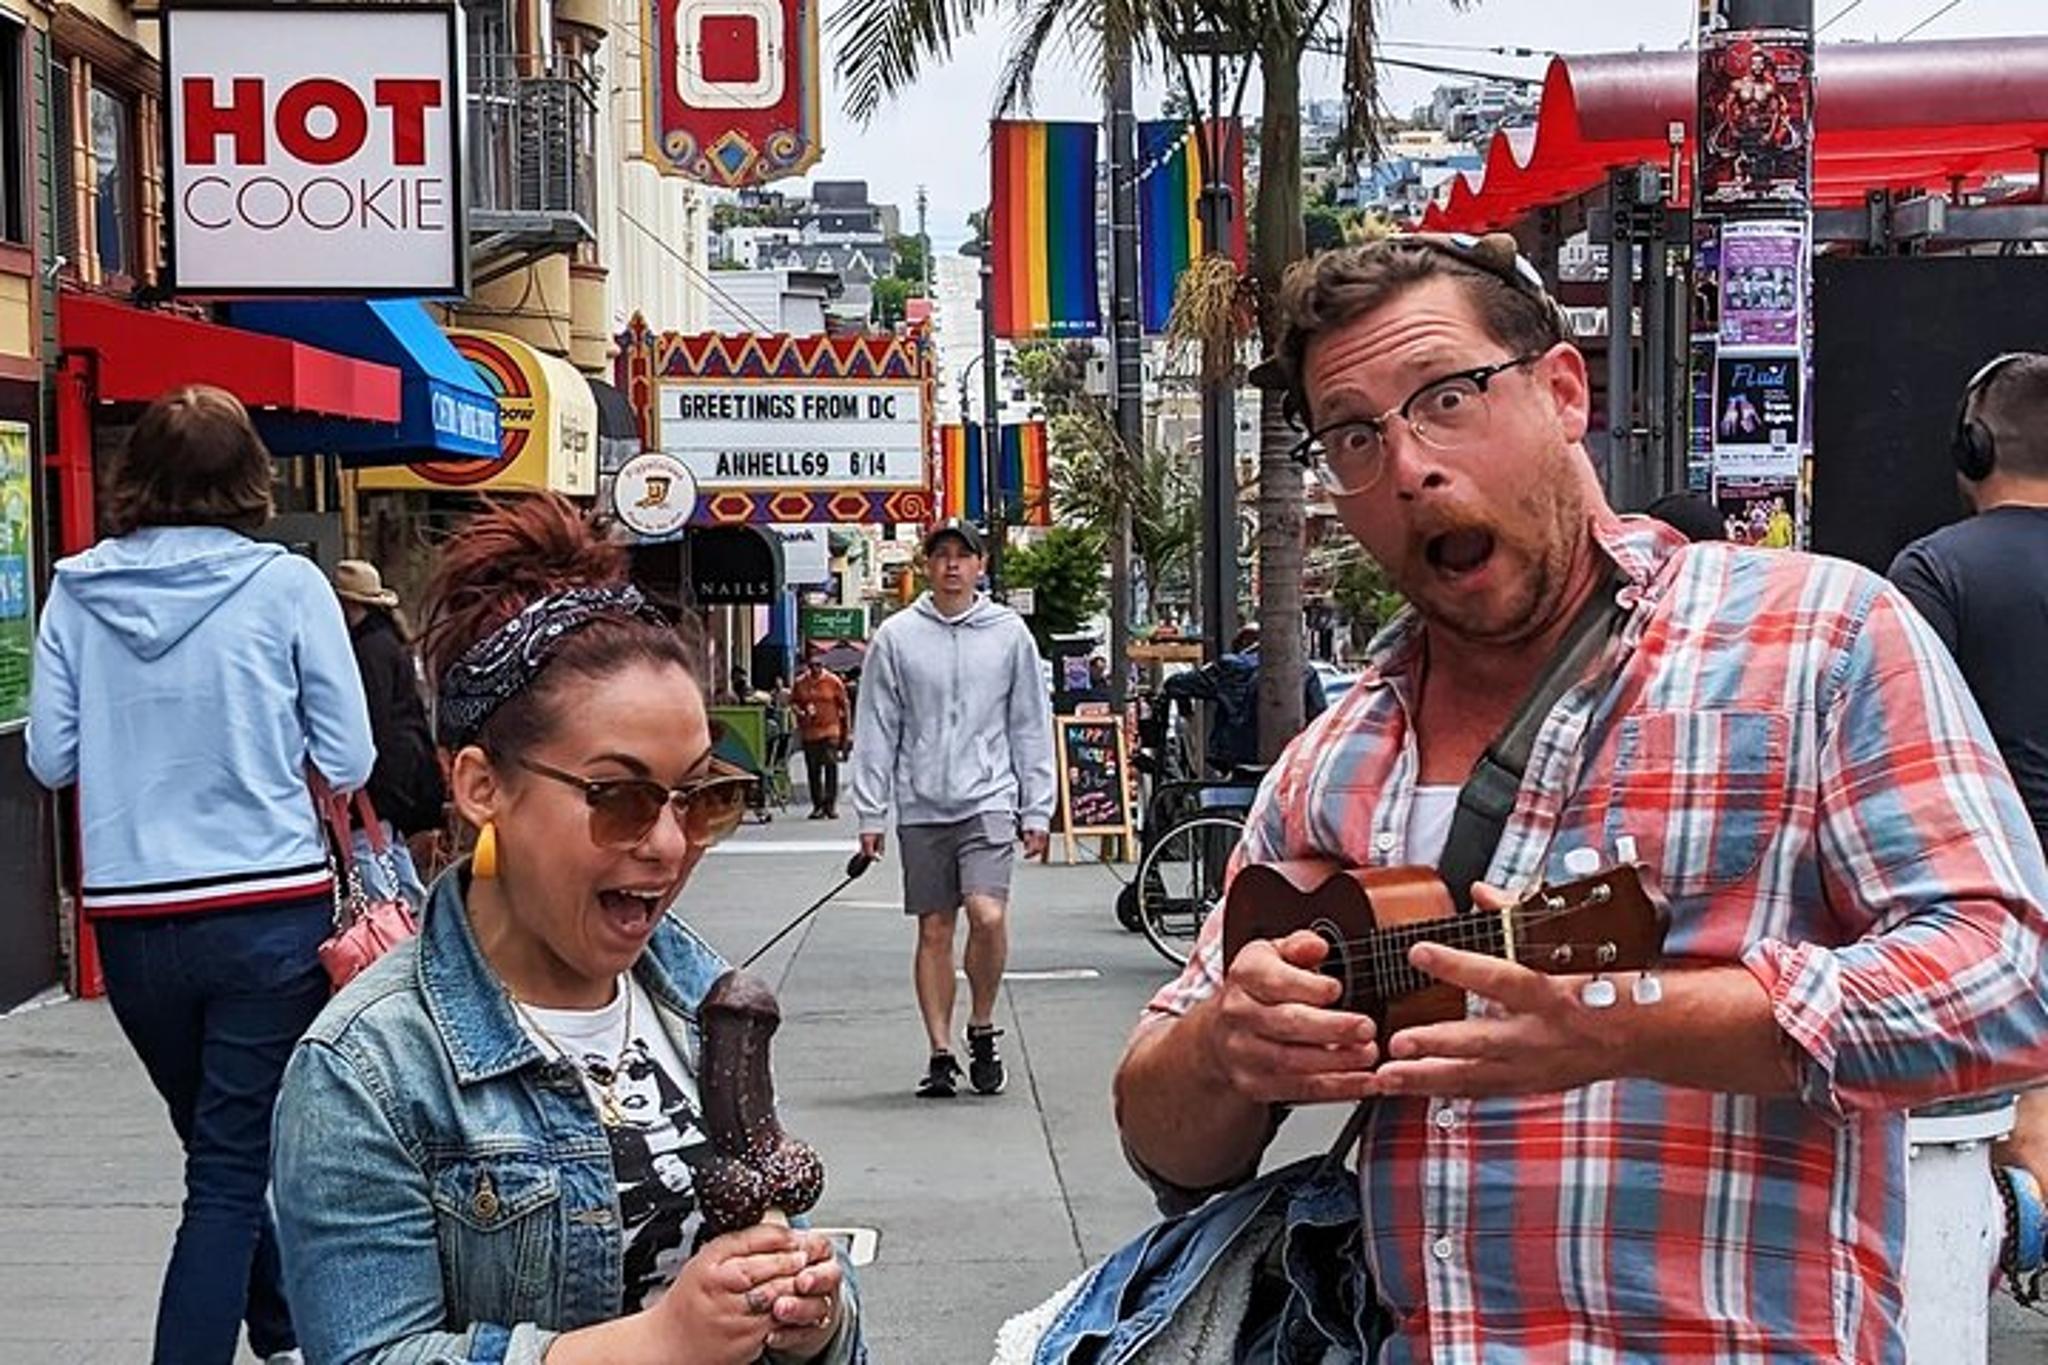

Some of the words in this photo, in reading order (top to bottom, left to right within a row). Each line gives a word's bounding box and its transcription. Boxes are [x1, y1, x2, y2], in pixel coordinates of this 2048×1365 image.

[181, 77, 443, 166] HOT
[183, 176, 445, 231] COOKIE
[680, 395, 796, 419] GREETINGS
[803, 395, 859, 418] FROM
[868, 395, 897, 418] DC
[716, 452, 829, 476] ANHELL69
[849, 452, 887, 476] 6/14
[701, 582, 769, 596] NAILS
